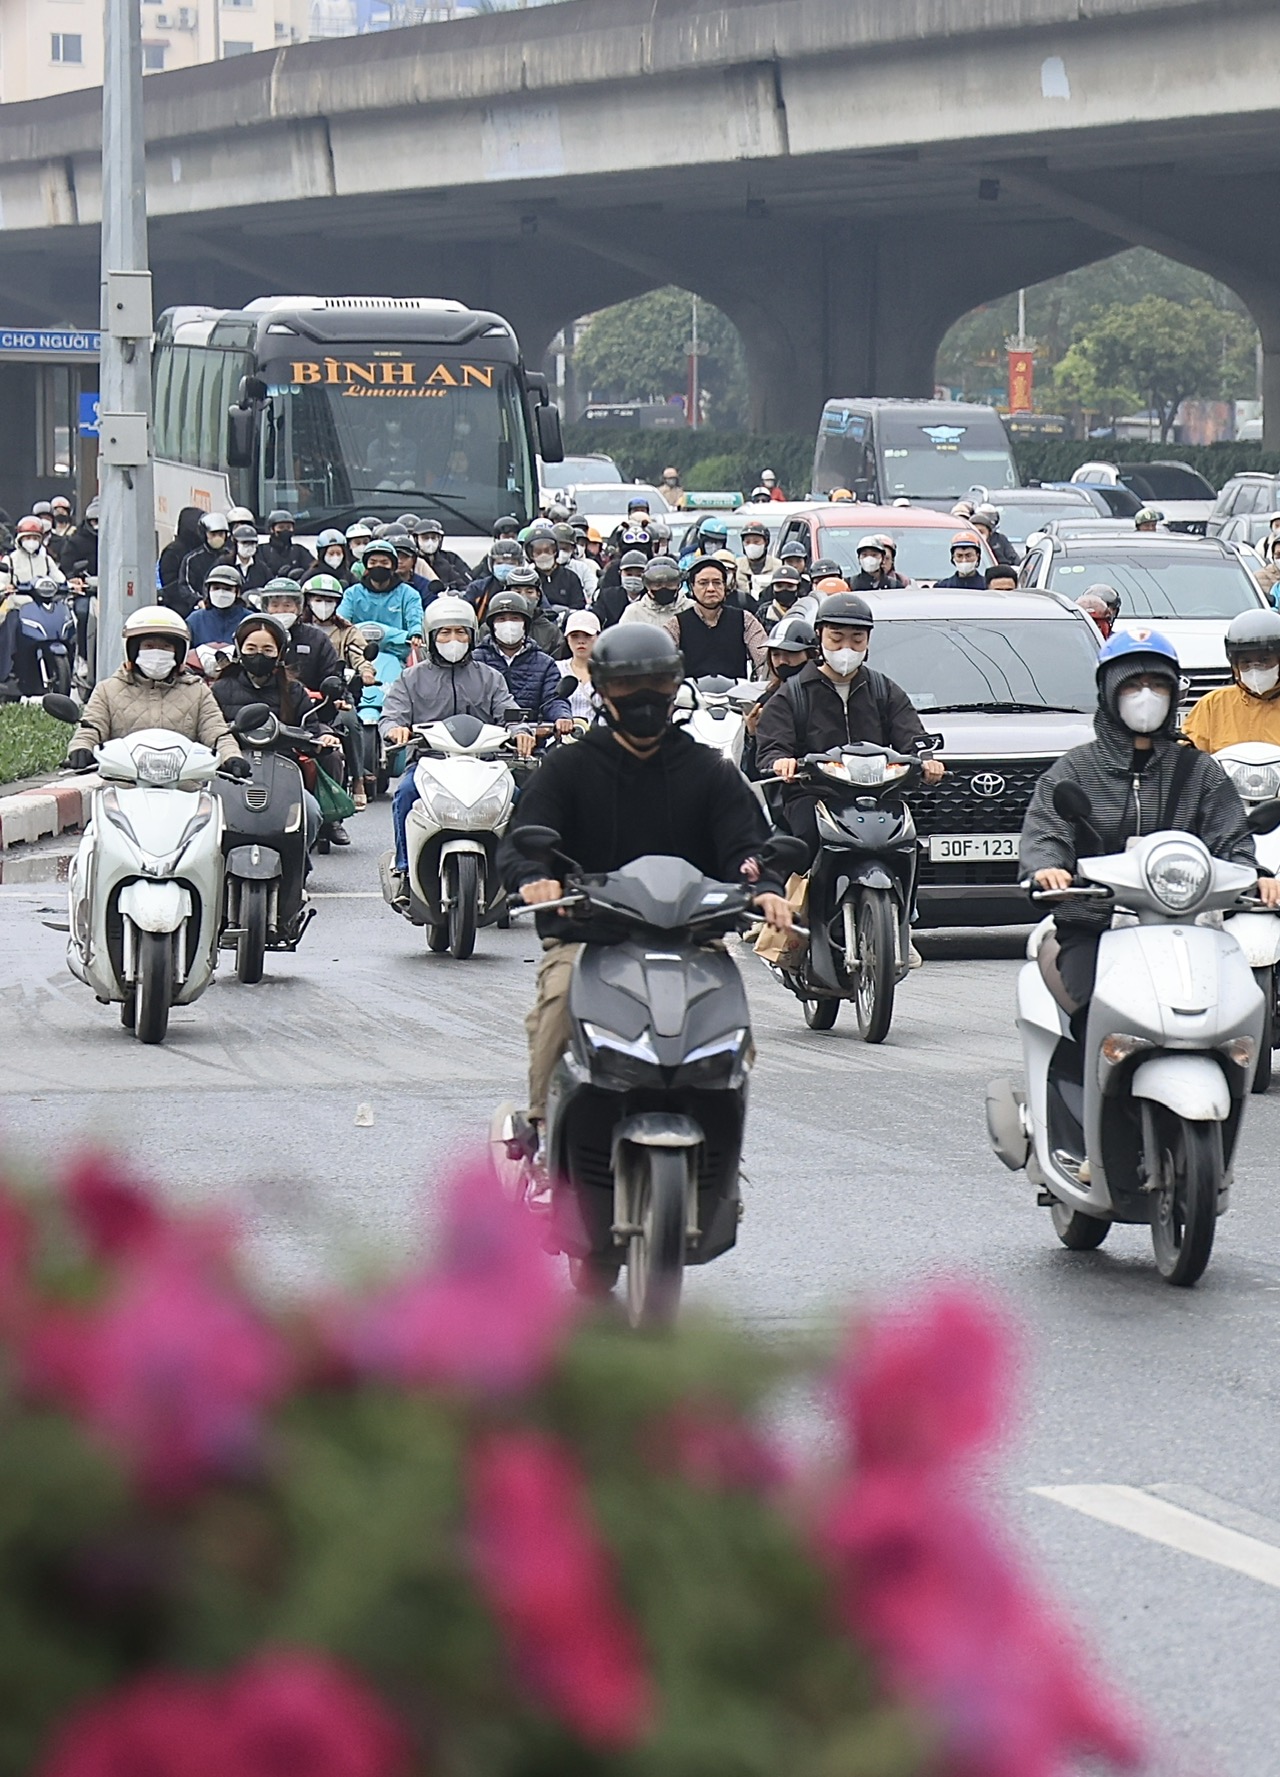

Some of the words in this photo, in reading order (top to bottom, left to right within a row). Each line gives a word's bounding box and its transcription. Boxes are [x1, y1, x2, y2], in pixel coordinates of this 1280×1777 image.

[2, 333, 35, 348] CHO
[40, 333, 88, 349] NGƯỜI
[290, 357, 416, 384] BÌNH
[425, 363, 495, 388] AN
[342, 383, 448, 398] Limousine
